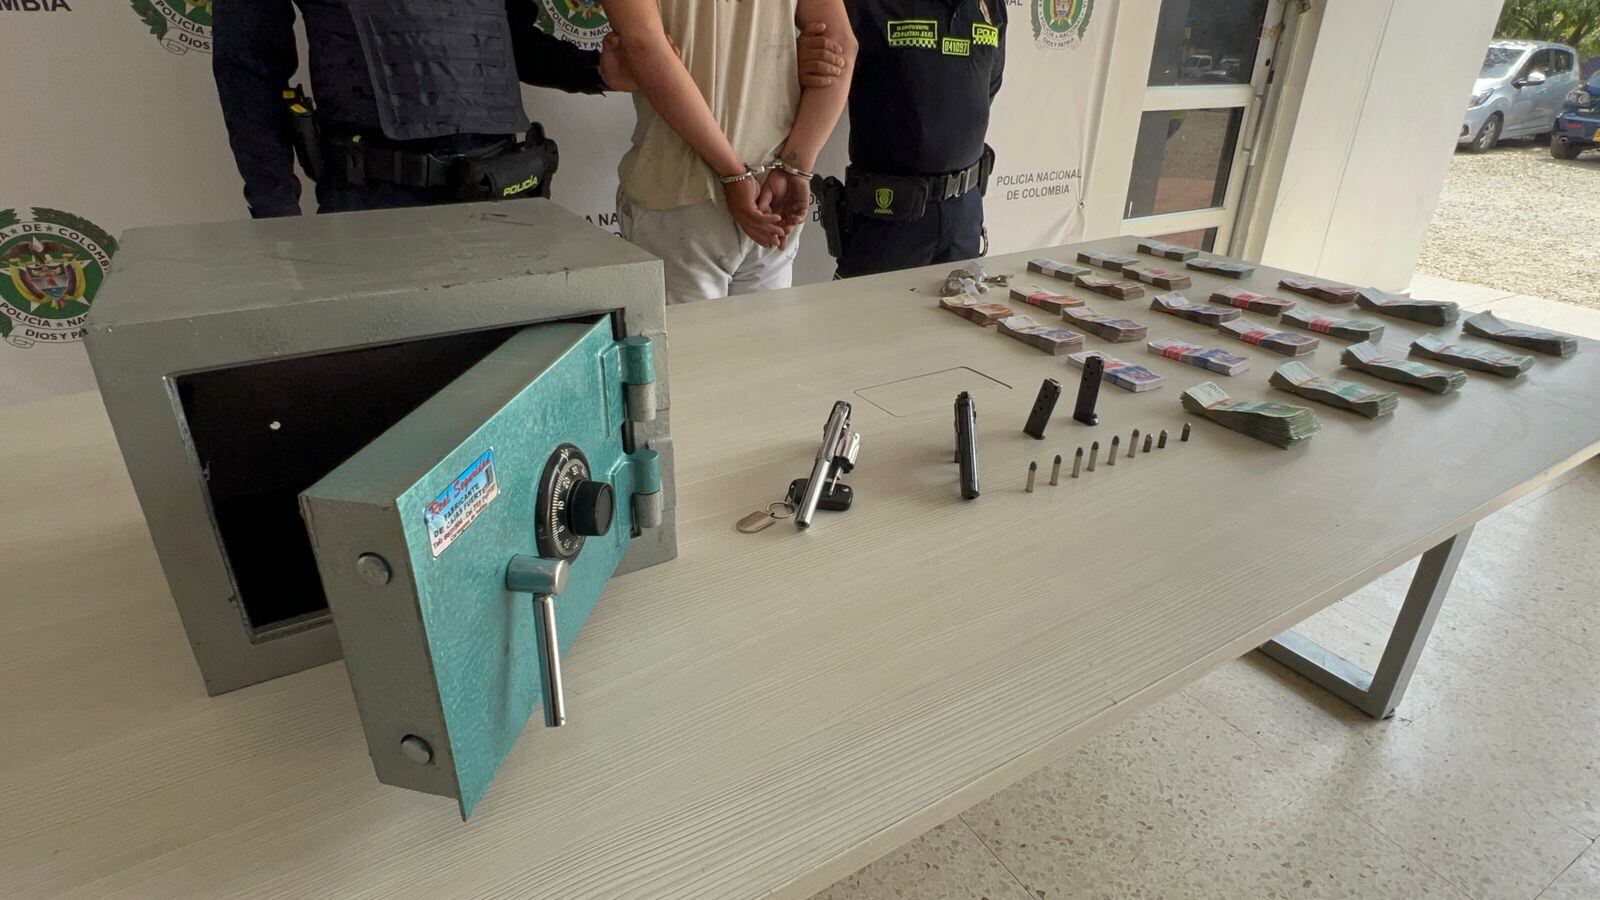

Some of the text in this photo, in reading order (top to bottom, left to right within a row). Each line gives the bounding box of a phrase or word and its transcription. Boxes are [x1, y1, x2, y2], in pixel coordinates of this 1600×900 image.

[155, 1, 204, 34] POLICIA
[548, 6, 579, 35] POLICIA
[179, 33, 210, 50] DIOS
[944, 41, 967, 53] 041097
[996, 169, 1082, 186] POLICIA NACIONAL
[1007, 185, 1070, 200] DE COLOMBIA
[22, 223, 42, 232] DE
[0, 302, 51, 327] POLICIA
[434, 526, 444, 537] DE
